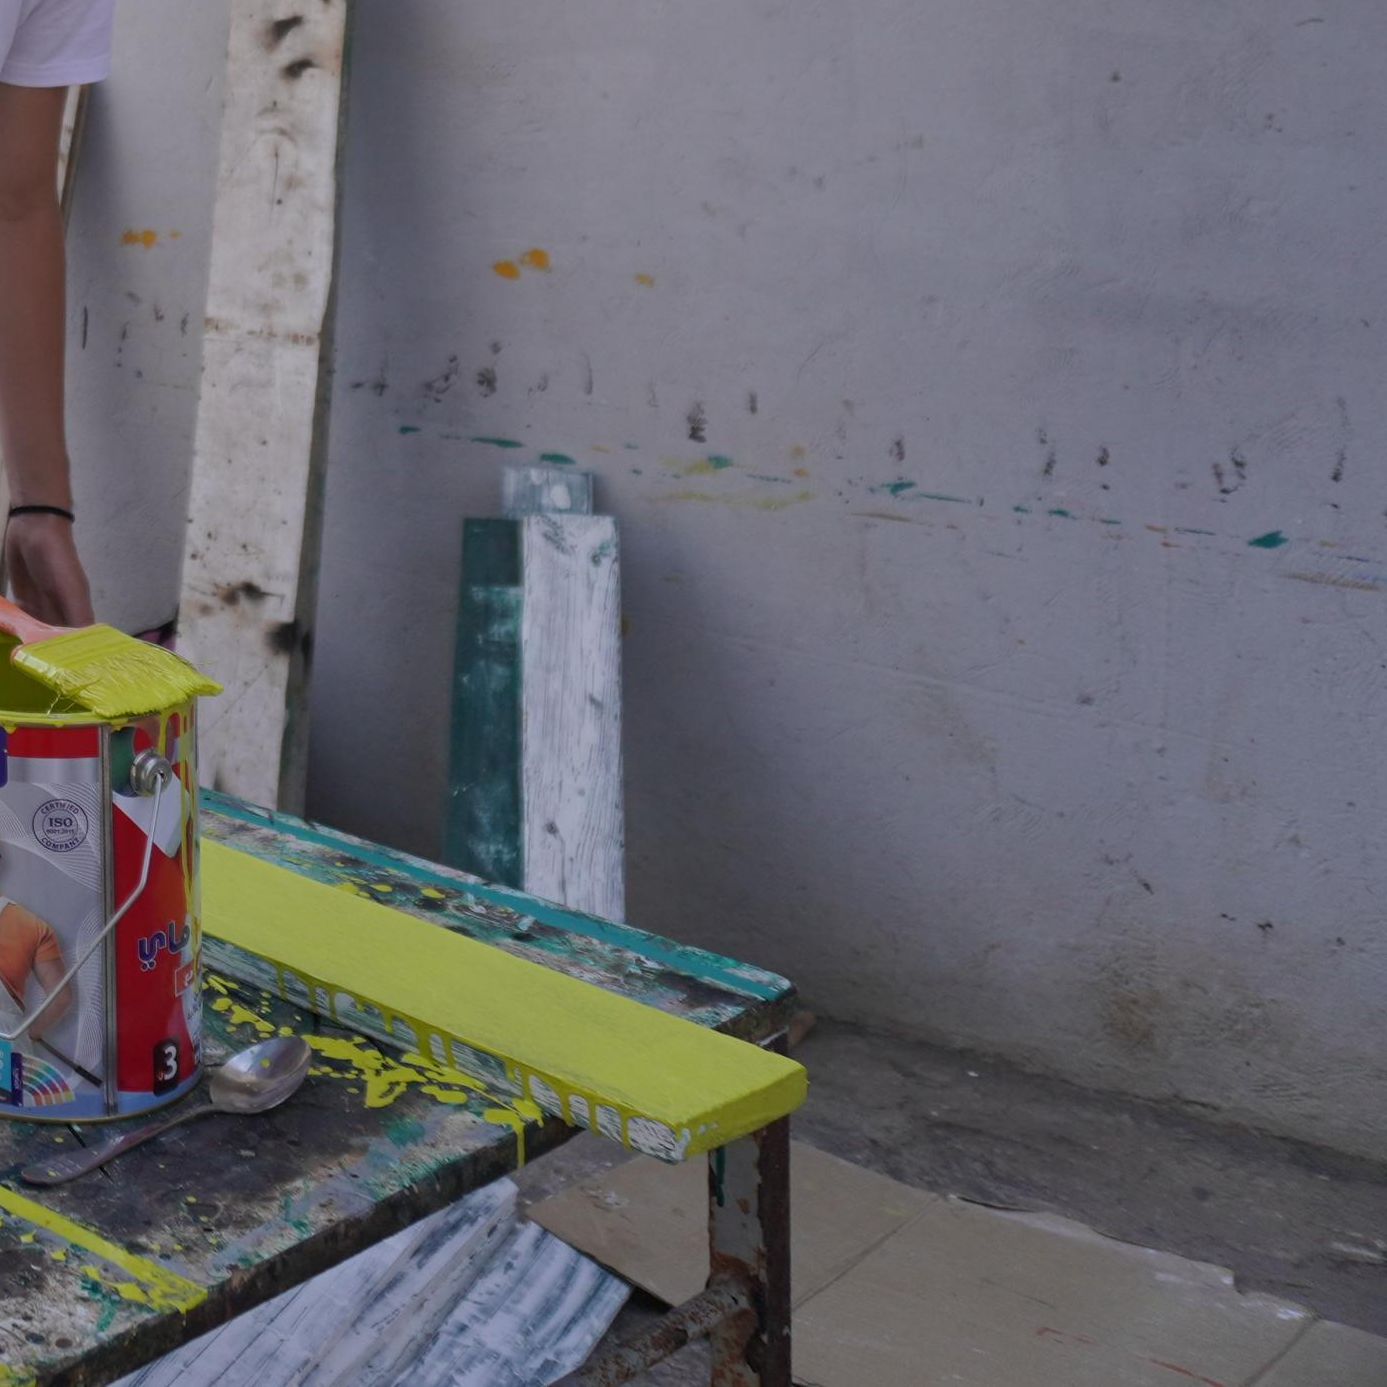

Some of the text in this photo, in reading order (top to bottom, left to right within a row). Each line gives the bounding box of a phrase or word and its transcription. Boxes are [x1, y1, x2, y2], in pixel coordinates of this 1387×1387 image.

[41, 802, 79, 815] CERTIFIED
[48, 817, 73, 828] ISO
[41, 837, 80, 850] COMPANY
[163, 1045, 178, 1081] 3
